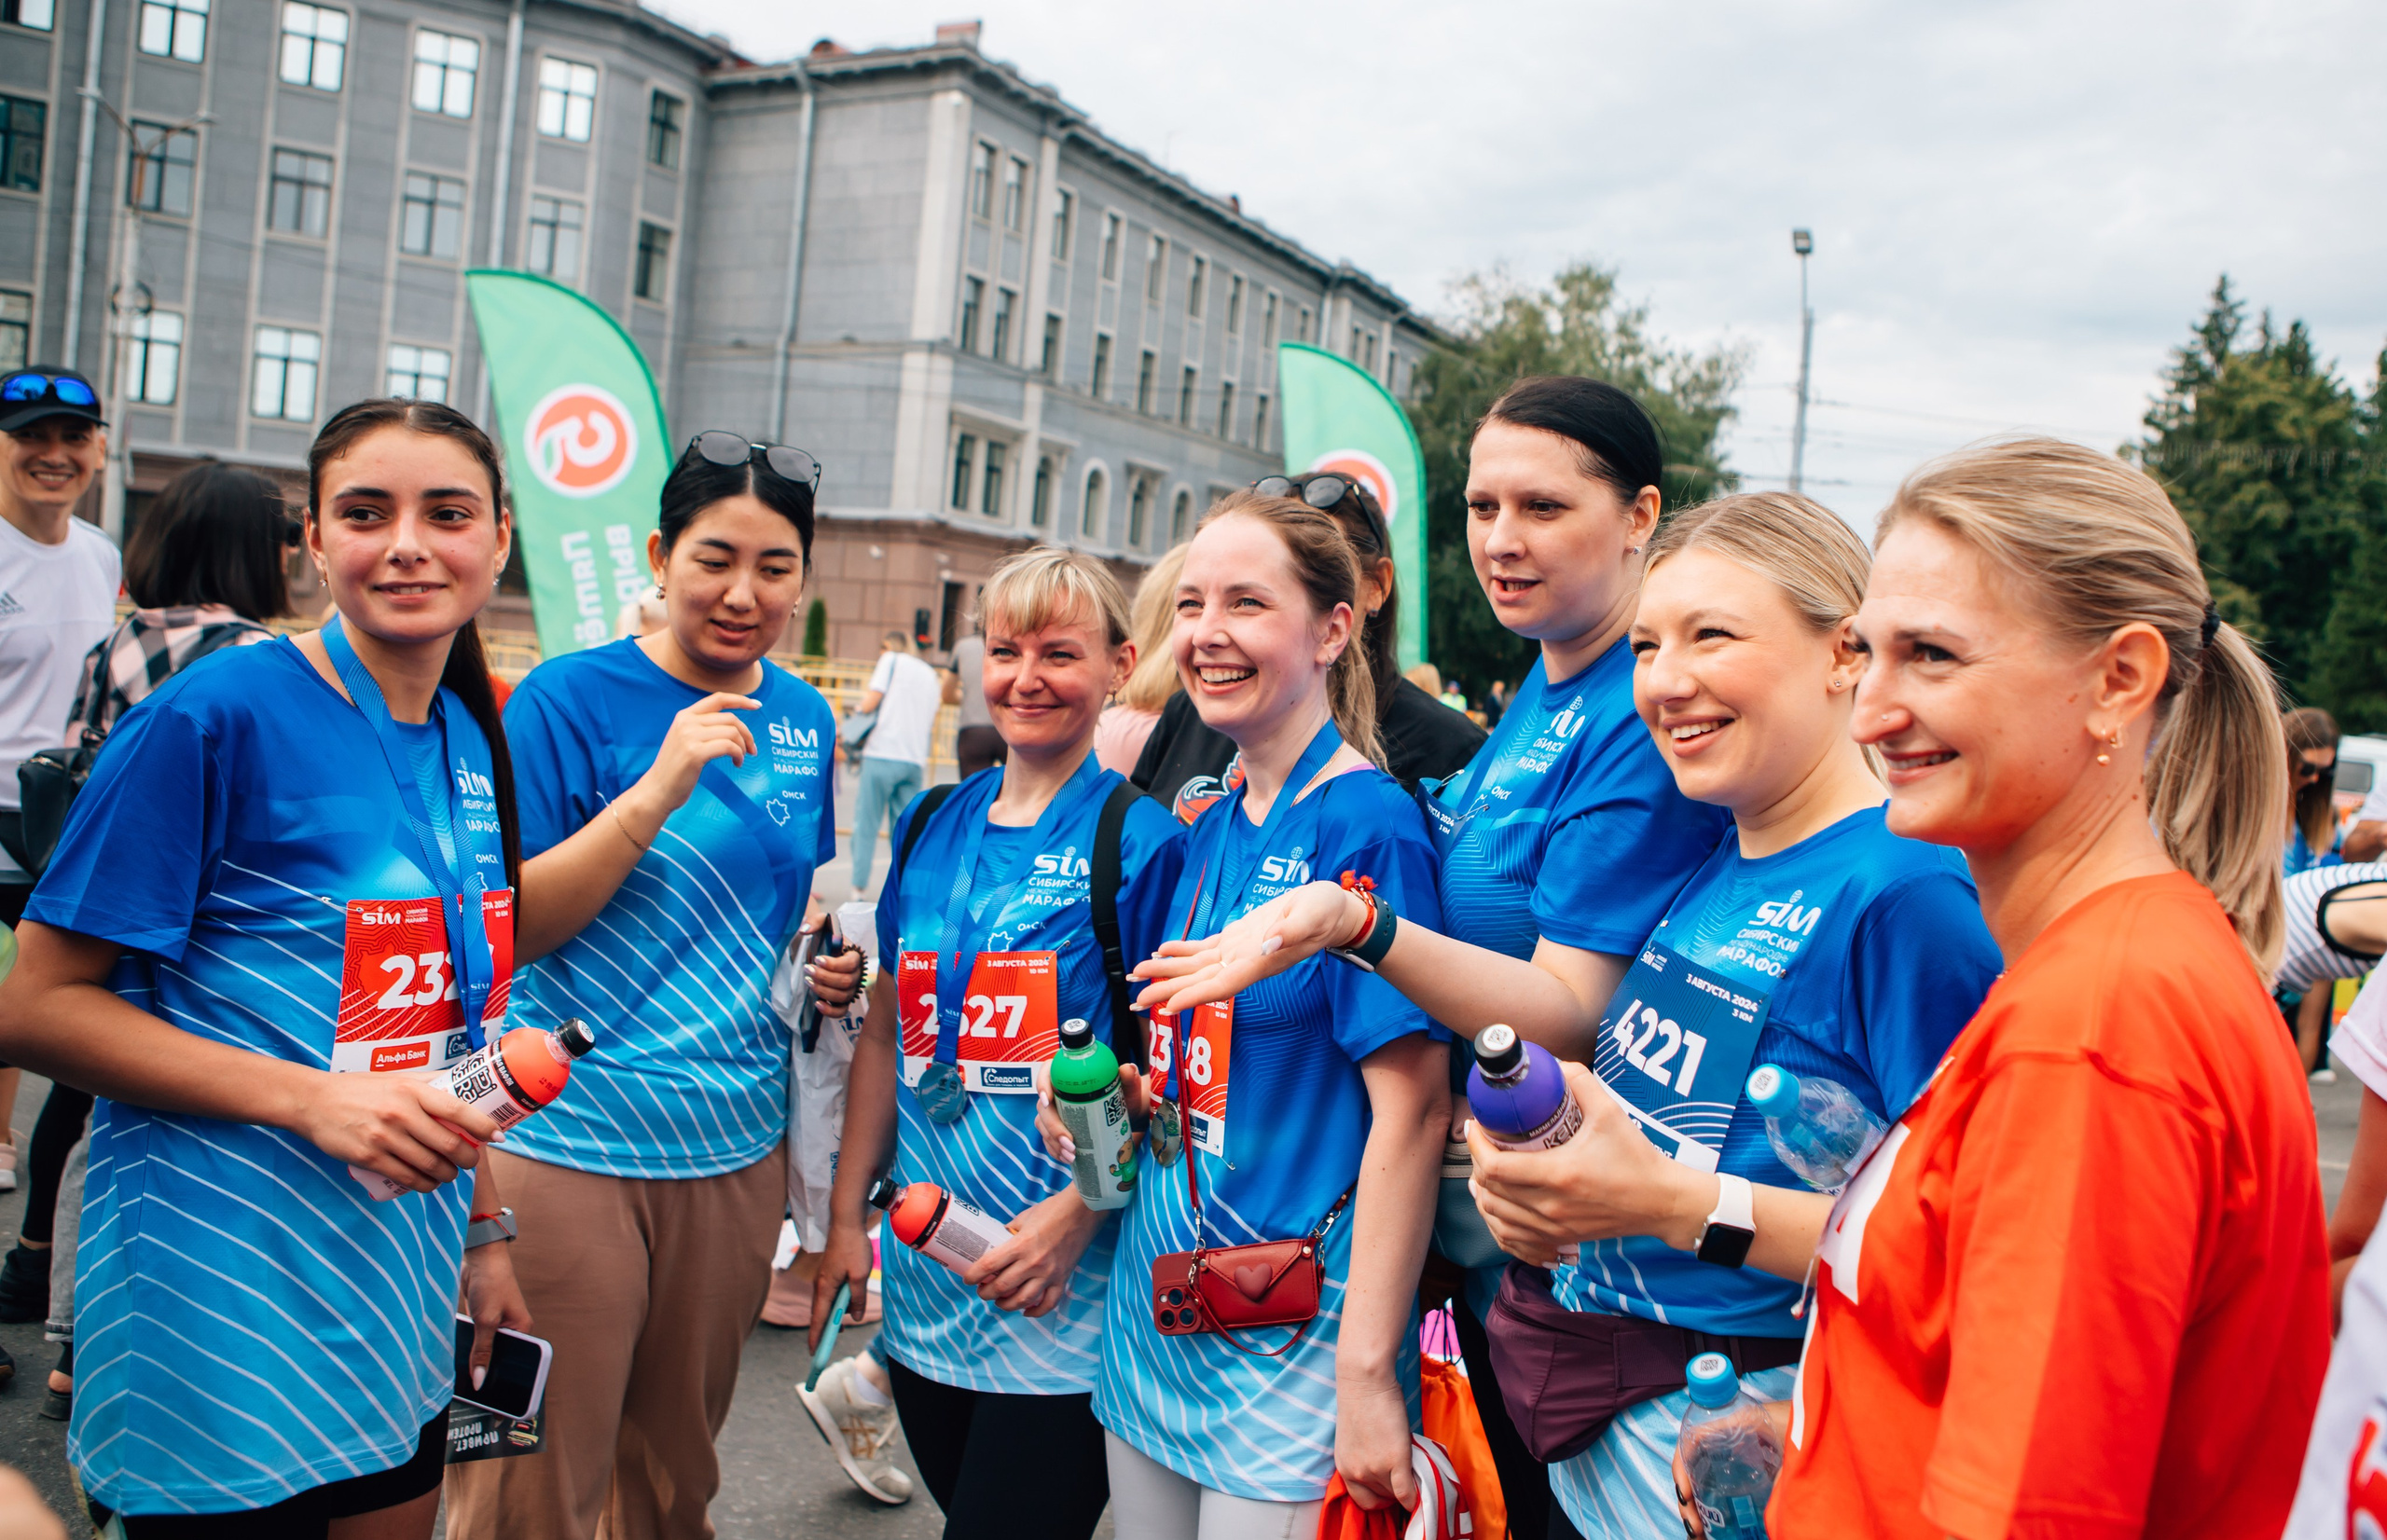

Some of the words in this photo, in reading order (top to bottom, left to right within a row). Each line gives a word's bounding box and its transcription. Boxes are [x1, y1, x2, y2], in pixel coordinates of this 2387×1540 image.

[773, 763, 819, 777] МАРАФО
[781, 790, 807, 800] ОМСК
[1690, 975, 1732, 1002] АВГУСТА
[1731, 994, 1759, 1013] 2024
[918, 993, 1028, 1038] 227
[1738, 1011, 1754, 1024] КМ
[1612, 998, 1707, 1098] 4221
[376, 1053, 406, 1064] Альфа
[407, 1049, 426, 1061] Банк
[987, 1074, 1029, 1084] Следопыт
